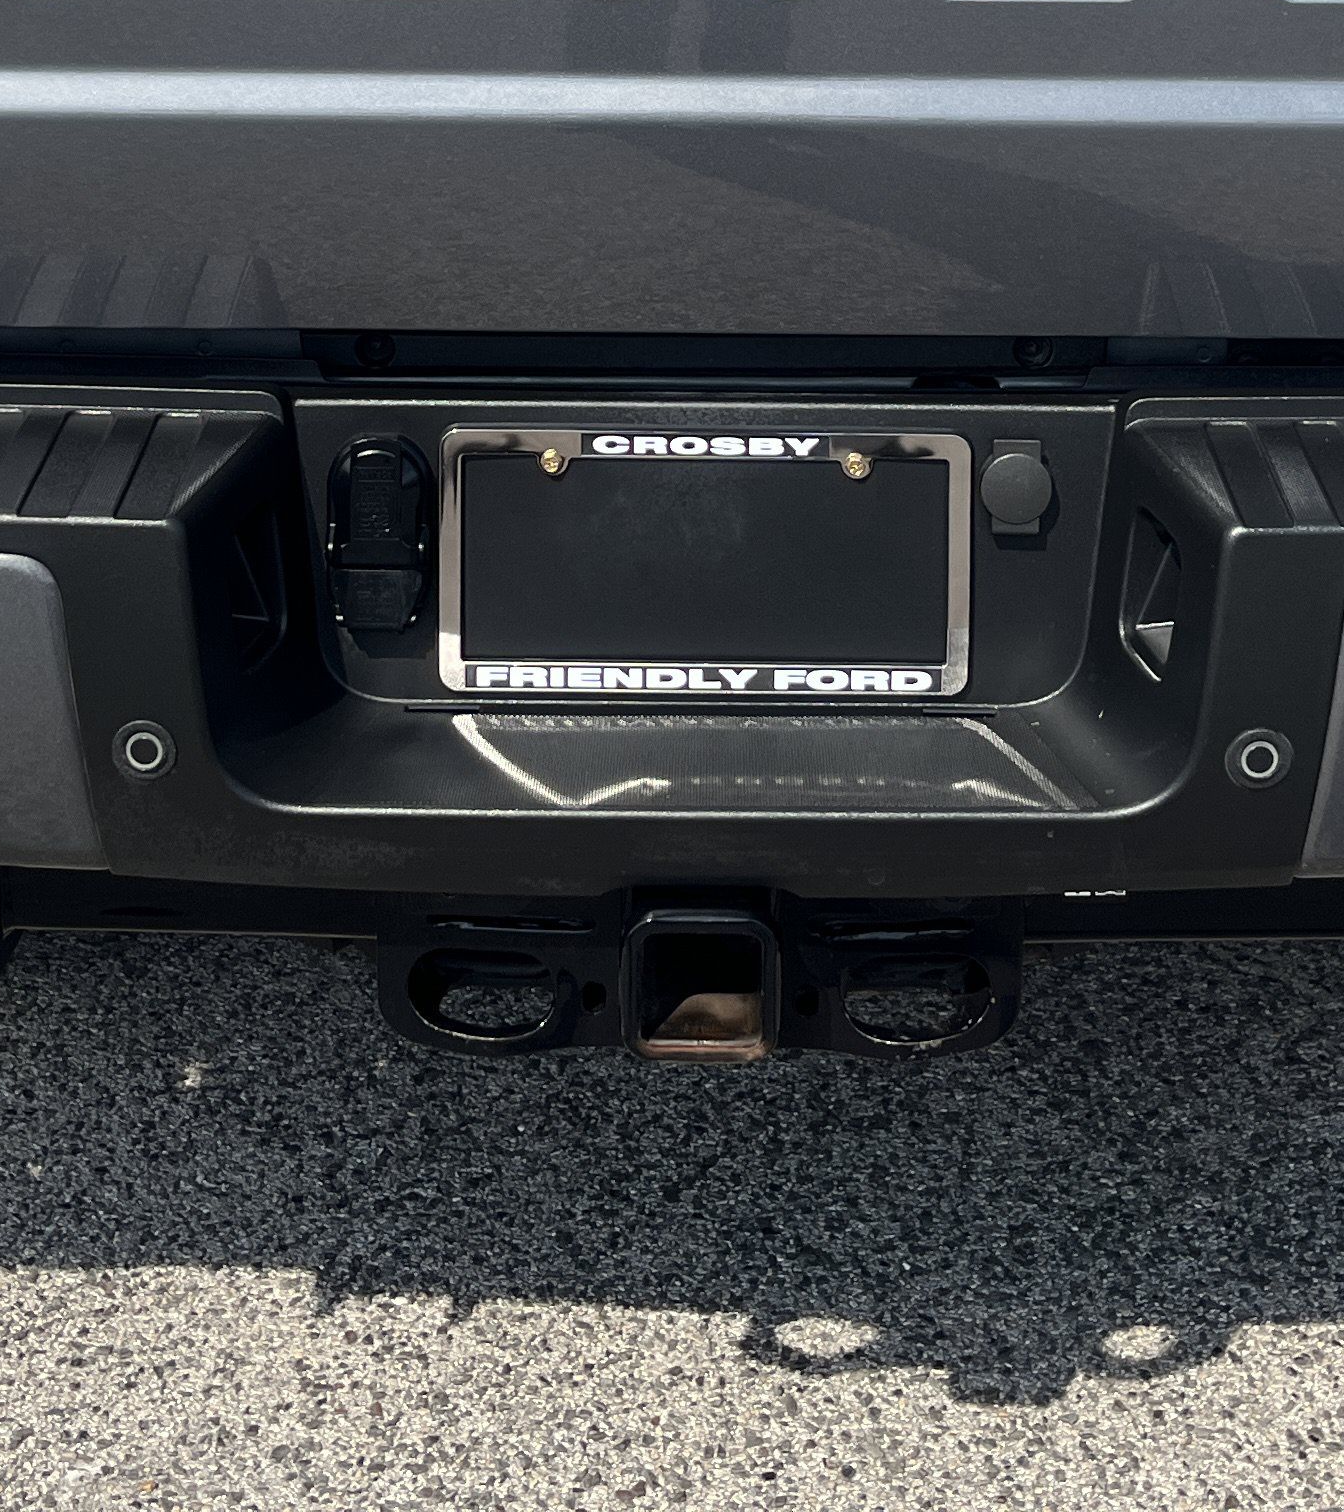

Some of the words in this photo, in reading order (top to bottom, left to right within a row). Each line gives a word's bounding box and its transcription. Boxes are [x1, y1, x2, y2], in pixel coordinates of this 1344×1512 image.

[591, 434, 821, 458] CROSBY
[474, 665, 758, 690] FRIENDLY
[772, 668, 934, 692] FORD
